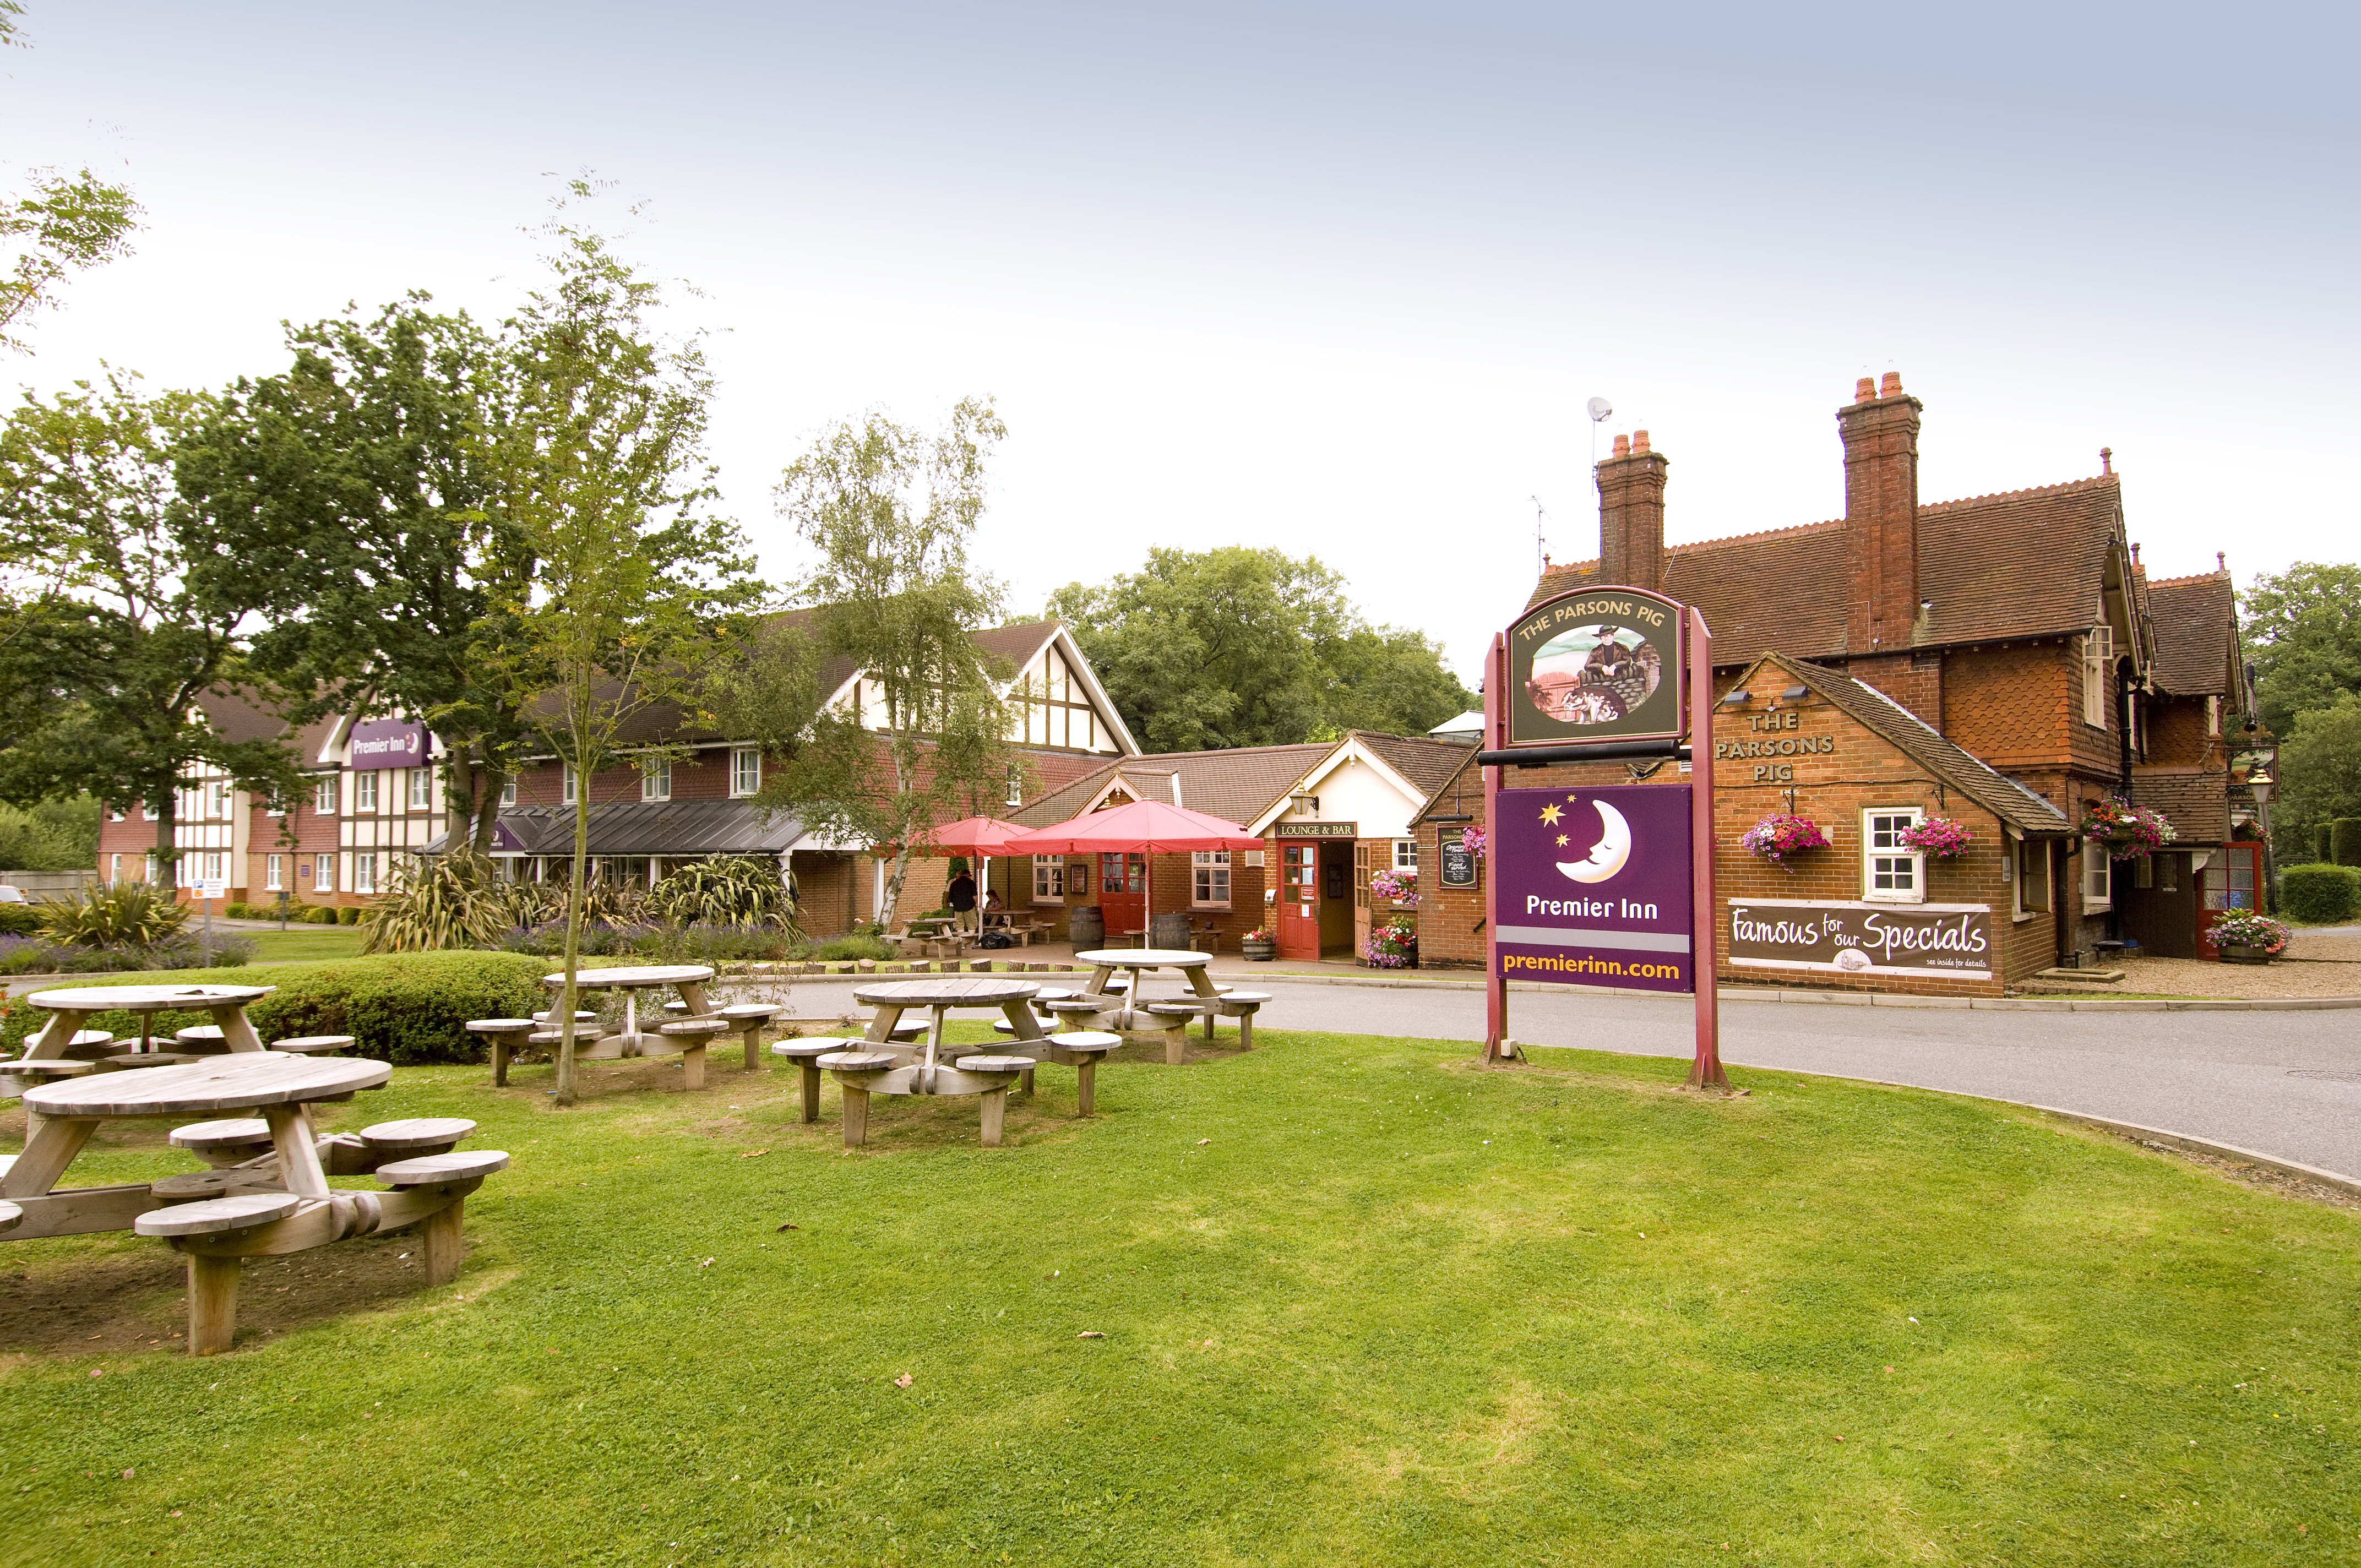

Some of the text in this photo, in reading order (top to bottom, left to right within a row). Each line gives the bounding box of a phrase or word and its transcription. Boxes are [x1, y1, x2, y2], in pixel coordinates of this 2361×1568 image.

[1519, 600, 1665, 641] THE PARSONS PIG
[1747, 712, 1798, 731] THE
[353, 736, 405, 755] Premier Inn
[1715, 736, 1834, 759] PARSONS
[1753, 764, 1793, 781] PIG
[1281, 825, 1352, 835] LOUNGE & BAR
[1526, 895, 1658, 919] Premier Inn
[1732, 907, 1987, 961] Famous for our Specials
[1504, 954, 1679, 979] premierinn.com
[1955, 958, 1964, 968] for
[1965, 959, 1987, 967] details
